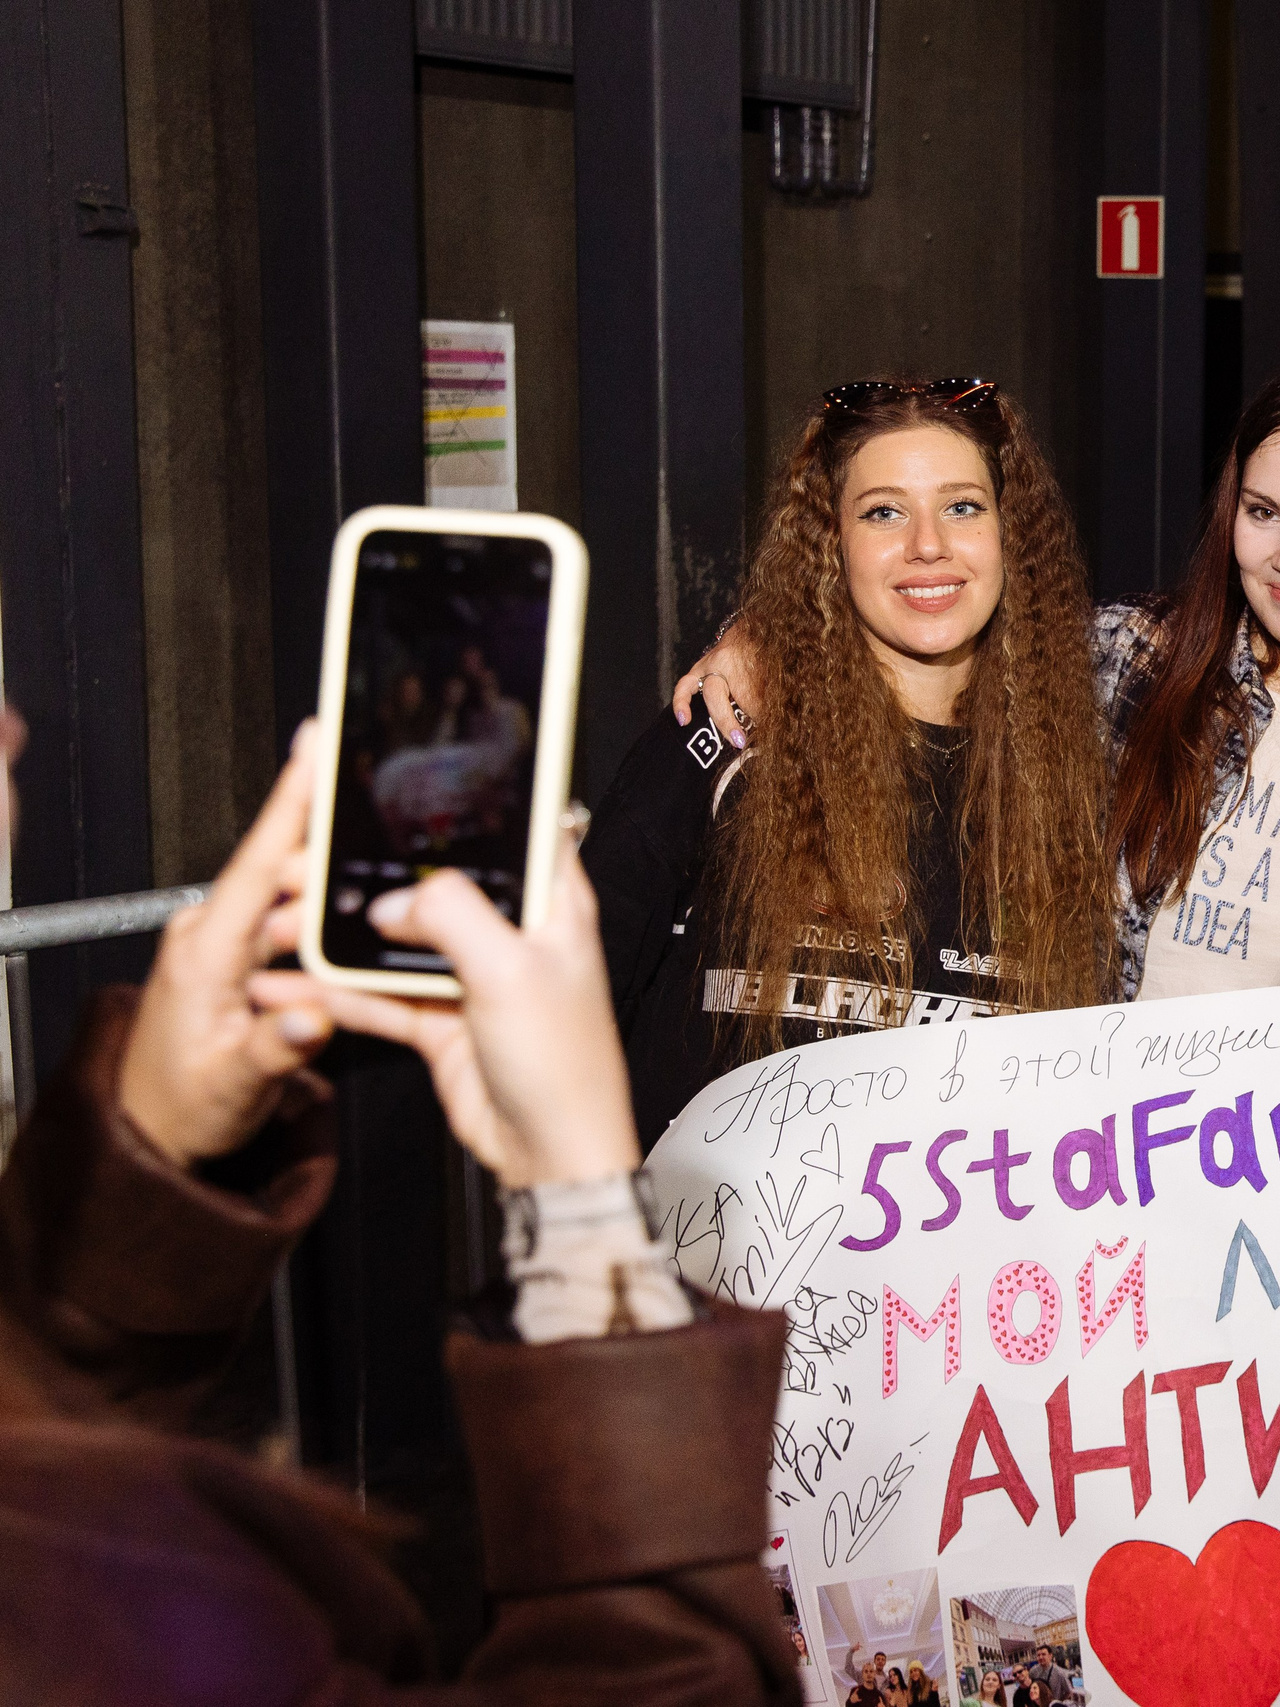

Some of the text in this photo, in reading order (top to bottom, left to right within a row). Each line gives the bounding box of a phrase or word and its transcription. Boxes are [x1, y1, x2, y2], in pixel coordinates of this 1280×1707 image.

[1172, 890, 1252, 961] IDEA
[938, 1029, 967, 1103] в
[999, 1010, 1126, 1095] этой
[1135, 1022, 1280, 1078] жизни
[881, 1235, 1149, 1400] МОЙ
